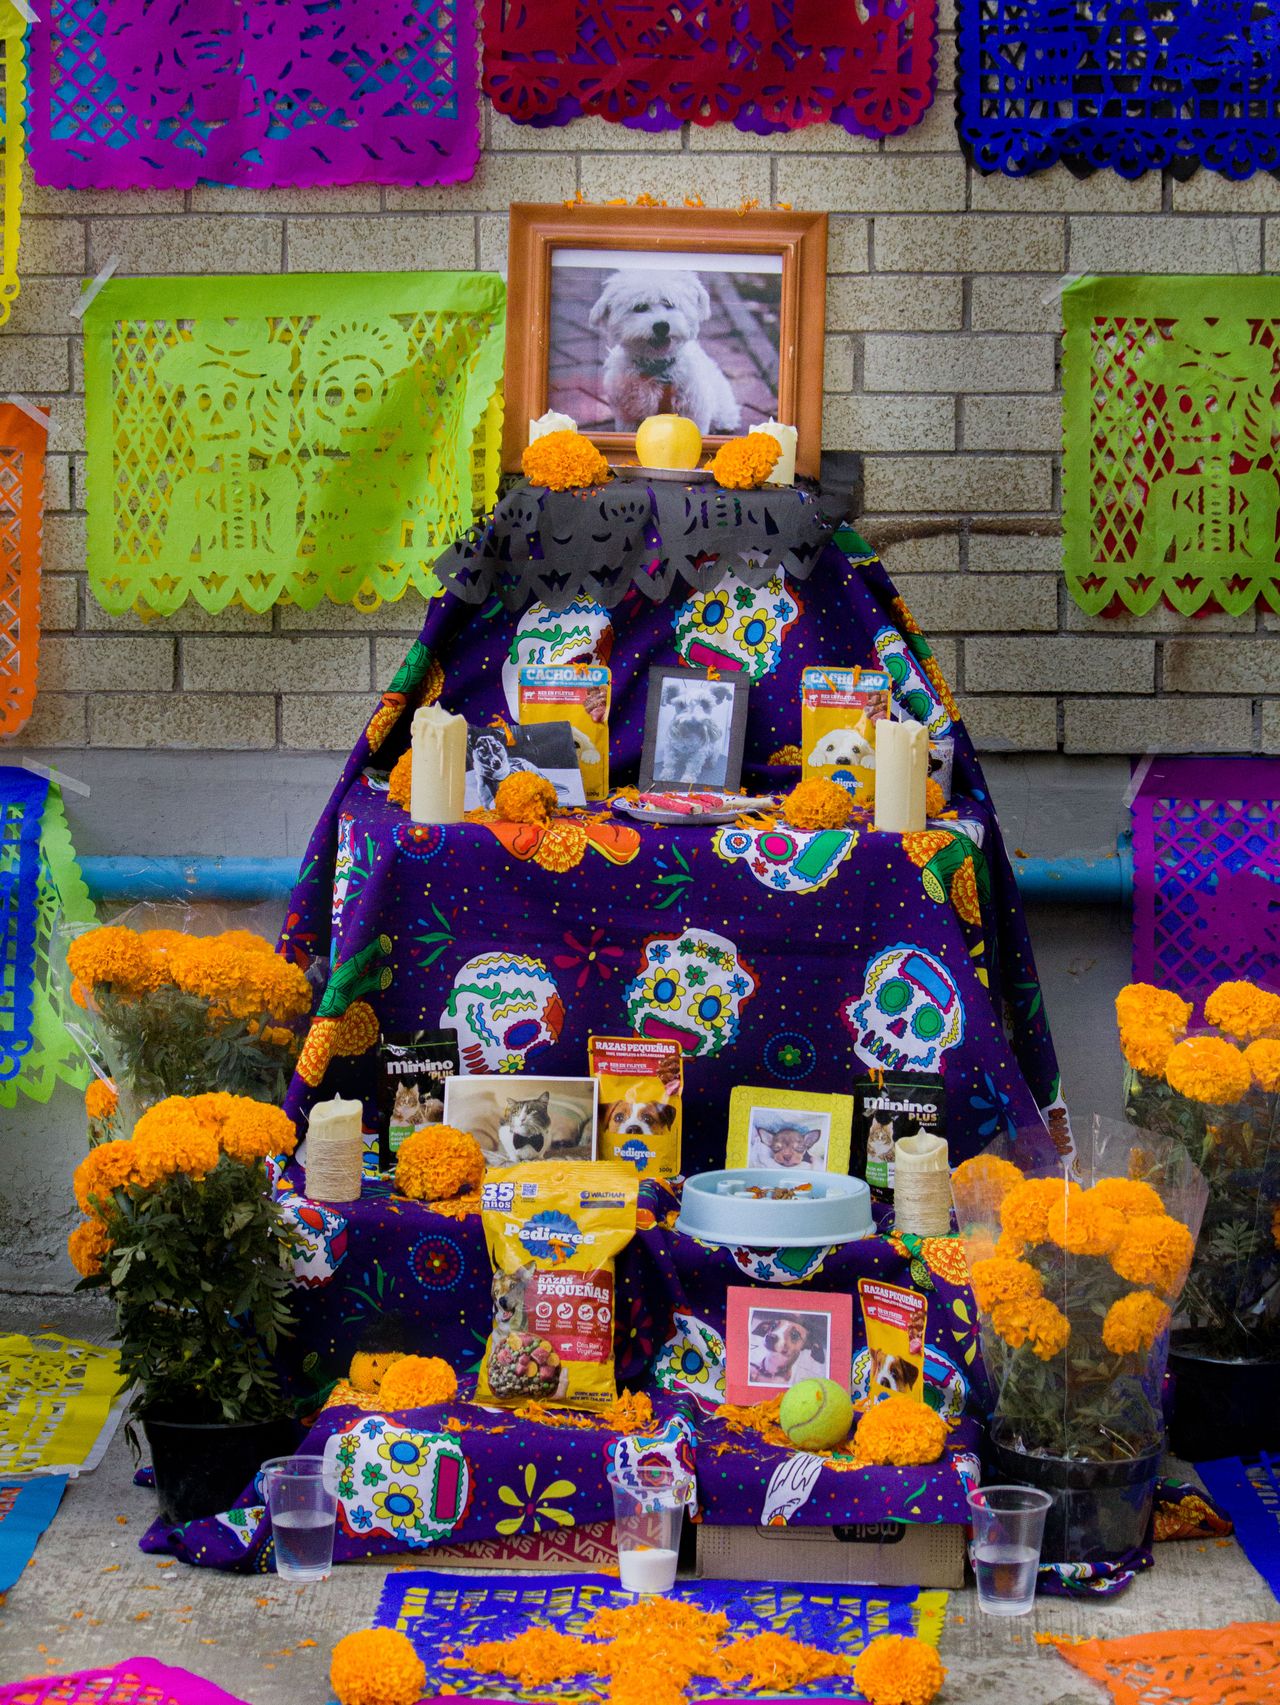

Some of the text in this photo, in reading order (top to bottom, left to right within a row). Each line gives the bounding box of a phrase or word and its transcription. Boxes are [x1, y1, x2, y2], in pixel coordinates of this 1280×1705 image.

[595, 1041, 676, 1054] RAZAS PEQUEÑAS
[909, 1112, 938, 1122] PLUS
[613, 1146, 657, 1160] Pedigree
[482, 1182, 515, 1201] 35
[484, 1199, 512, 1210] años
[538, 1276, 574, 1285] RAZAS
[537, 1282, 610, 1301] PEQUEÑAS
[863, 1284, 889, 1299] RAZAS
[888, 1290, 923, 1309] PEQUEÑAS
